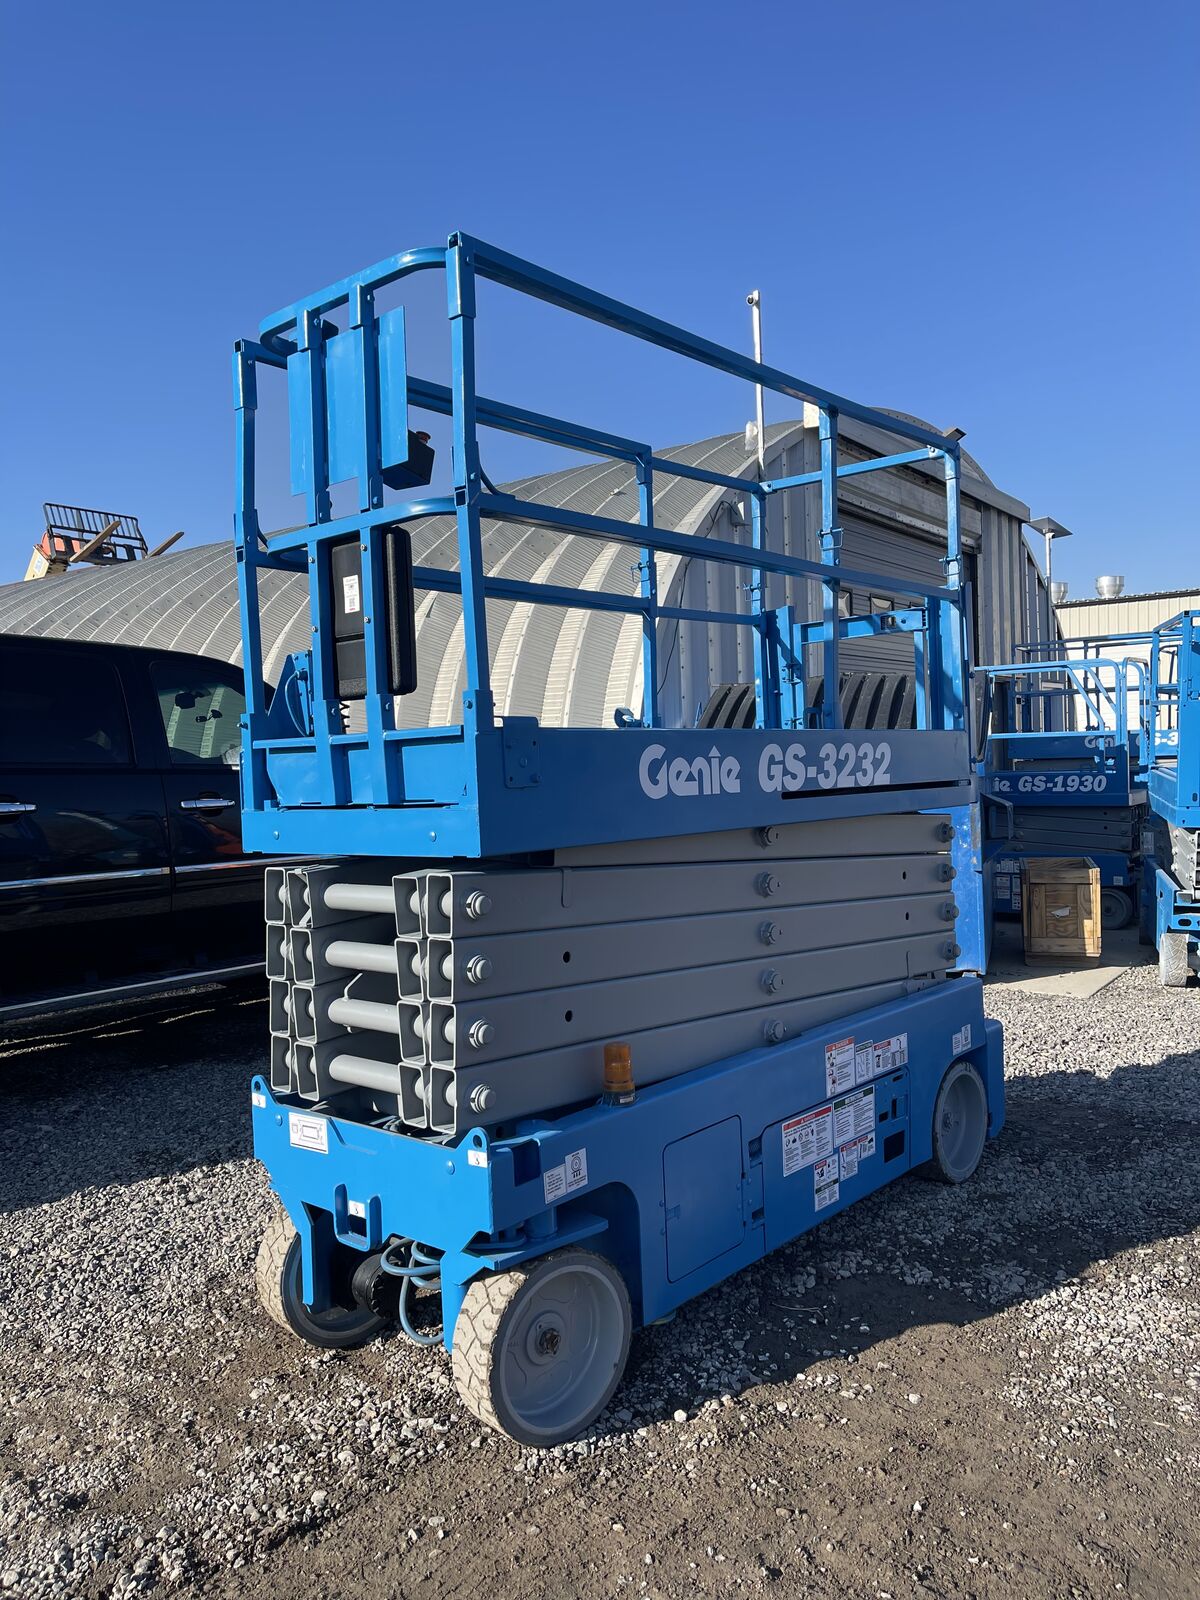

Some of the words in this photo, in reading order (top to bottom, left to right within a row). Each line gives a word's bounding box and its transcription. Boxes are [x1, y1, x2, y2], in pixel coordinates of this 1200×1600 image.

[638, 743, 741, 800] Genie
[758, 742, 892, 792] GS-3232
[1018, 775, 1107, 792] GS-1930
